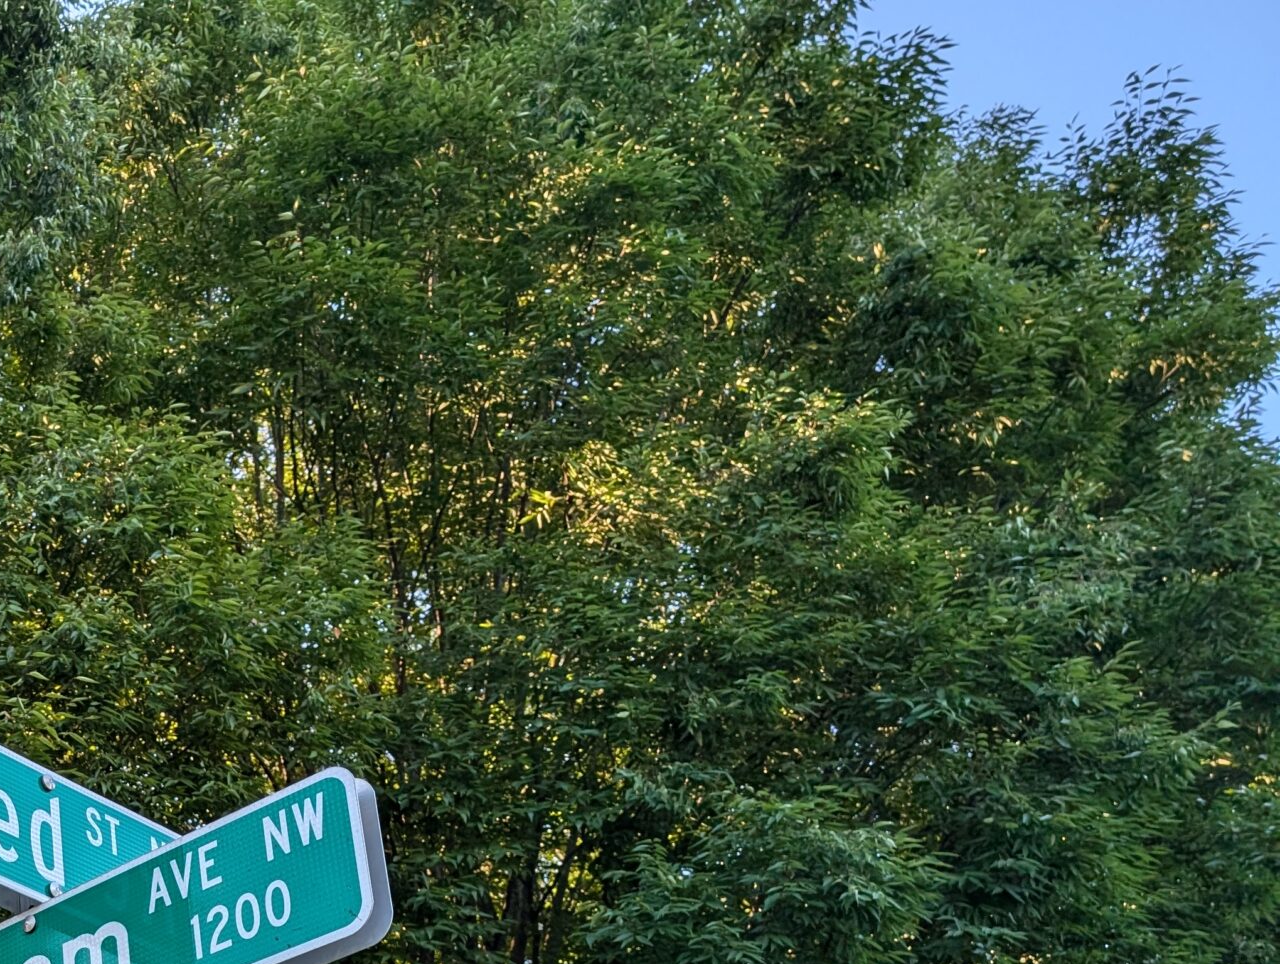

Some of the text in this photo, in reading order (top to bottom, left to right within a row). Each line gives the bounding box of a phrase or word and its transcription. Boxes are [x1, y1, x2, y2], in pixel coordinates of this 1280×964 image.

[86, 807, 120, 856] ST
[148, 840, 222, 914] AVE
[262, 792, 324, 861] NW
[190, 879, 291, 960] 1200
